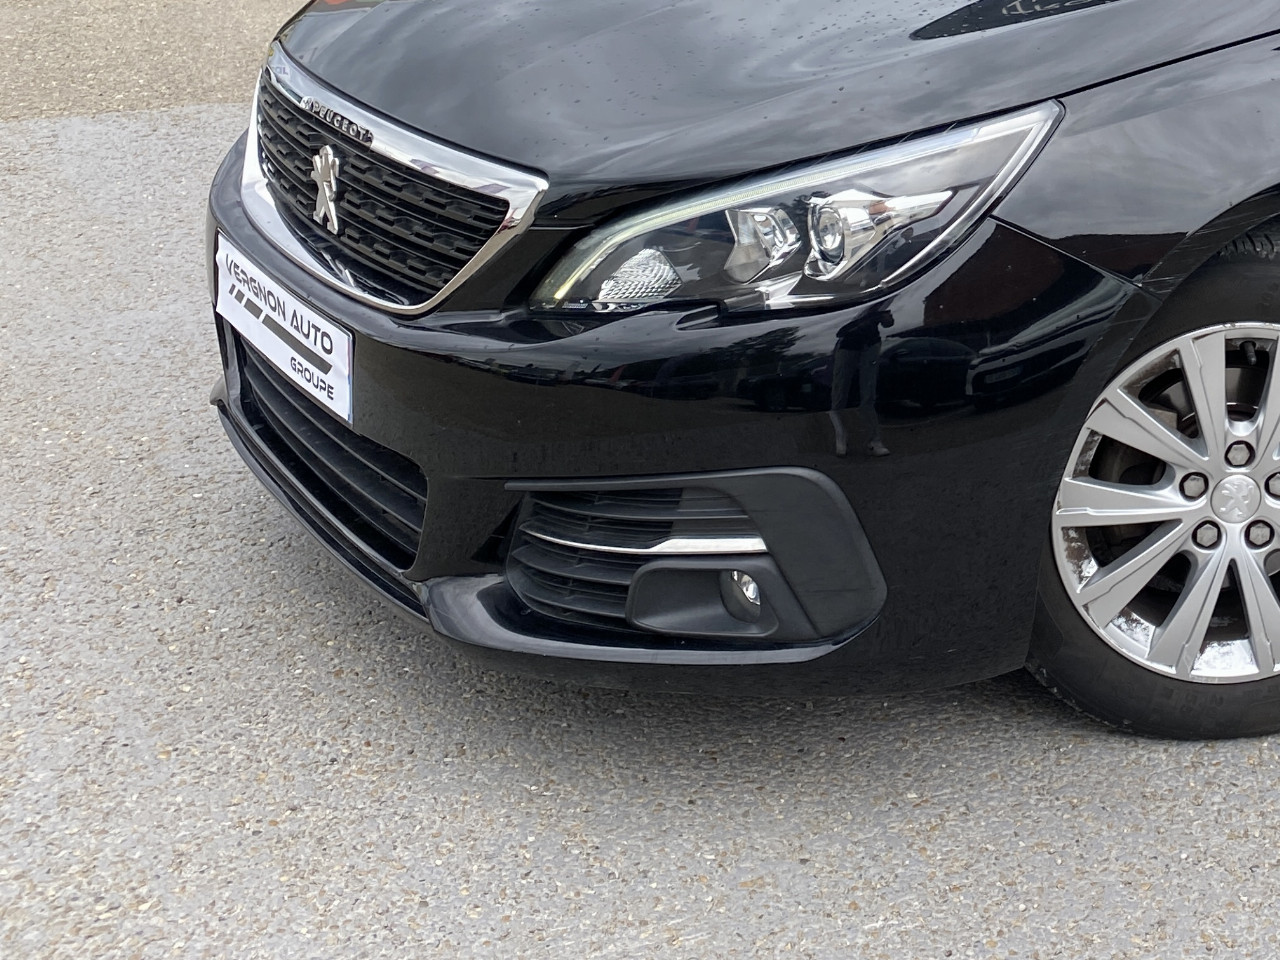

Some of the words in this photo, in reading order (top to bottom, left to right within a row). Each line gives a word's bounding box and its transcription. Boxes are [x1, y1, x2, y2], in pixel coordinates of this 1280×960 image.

[312, 100, 367, 141] PEUGEOT
[225, 253, 287, 322] VERGNON
[290, 309, 334, 356] AUTO
[290, 356, 335, 401] GROUPE
